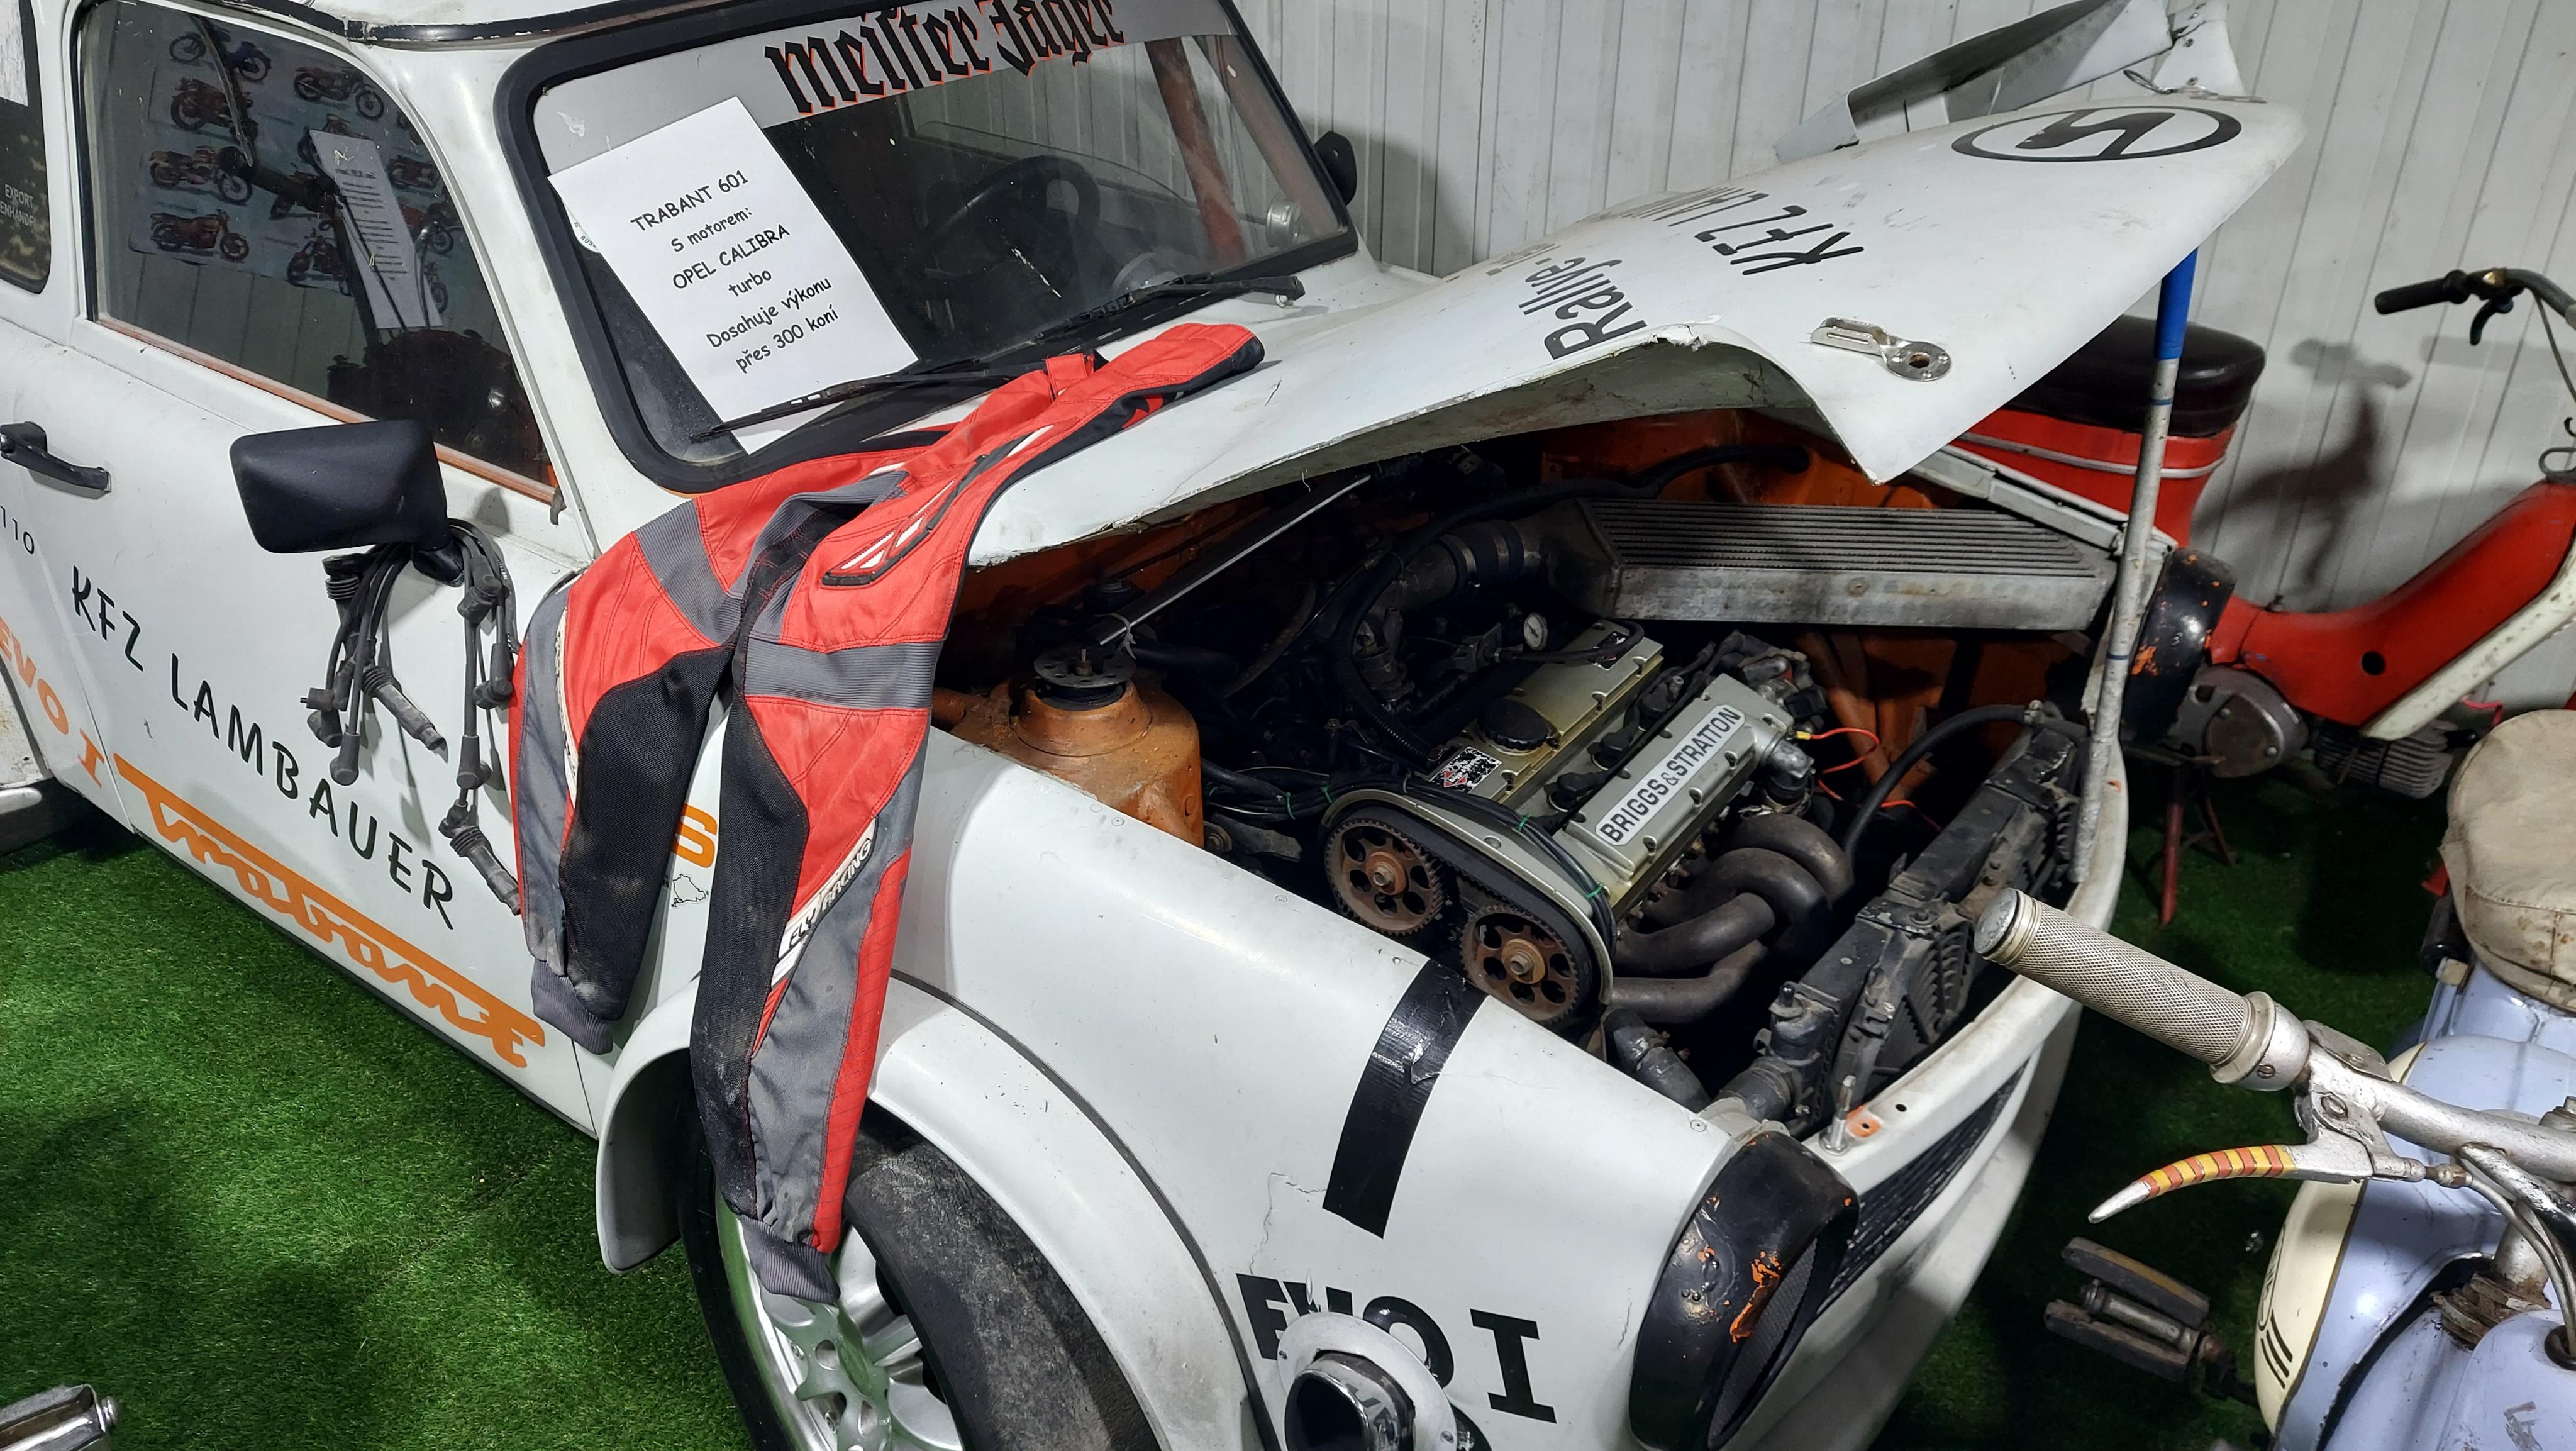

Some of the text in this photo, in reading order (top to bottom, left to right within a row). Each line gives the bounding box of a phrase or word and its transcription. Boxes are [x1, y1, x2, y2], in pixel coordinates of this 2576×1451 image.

[5, 184, 34, 209] EXPORT
[630, 170, 748, 231] TRABANT 601
[687, 207, 752, 245] motorem:
[672, 224, 791, 289] OPEL CALIBRA
[1694, 204, 1867, 276] KFZ
[706, 278, 832, 348] Dosahuje výkonu
[728, 270, 772, 297] turbo
[736, 304, 838, 374] přes 300 koní
[72, 565, 143, 672] KFZ
[172, 653, 453, 930] LAMBAUER
[821, 838, 874, 912] RACING
